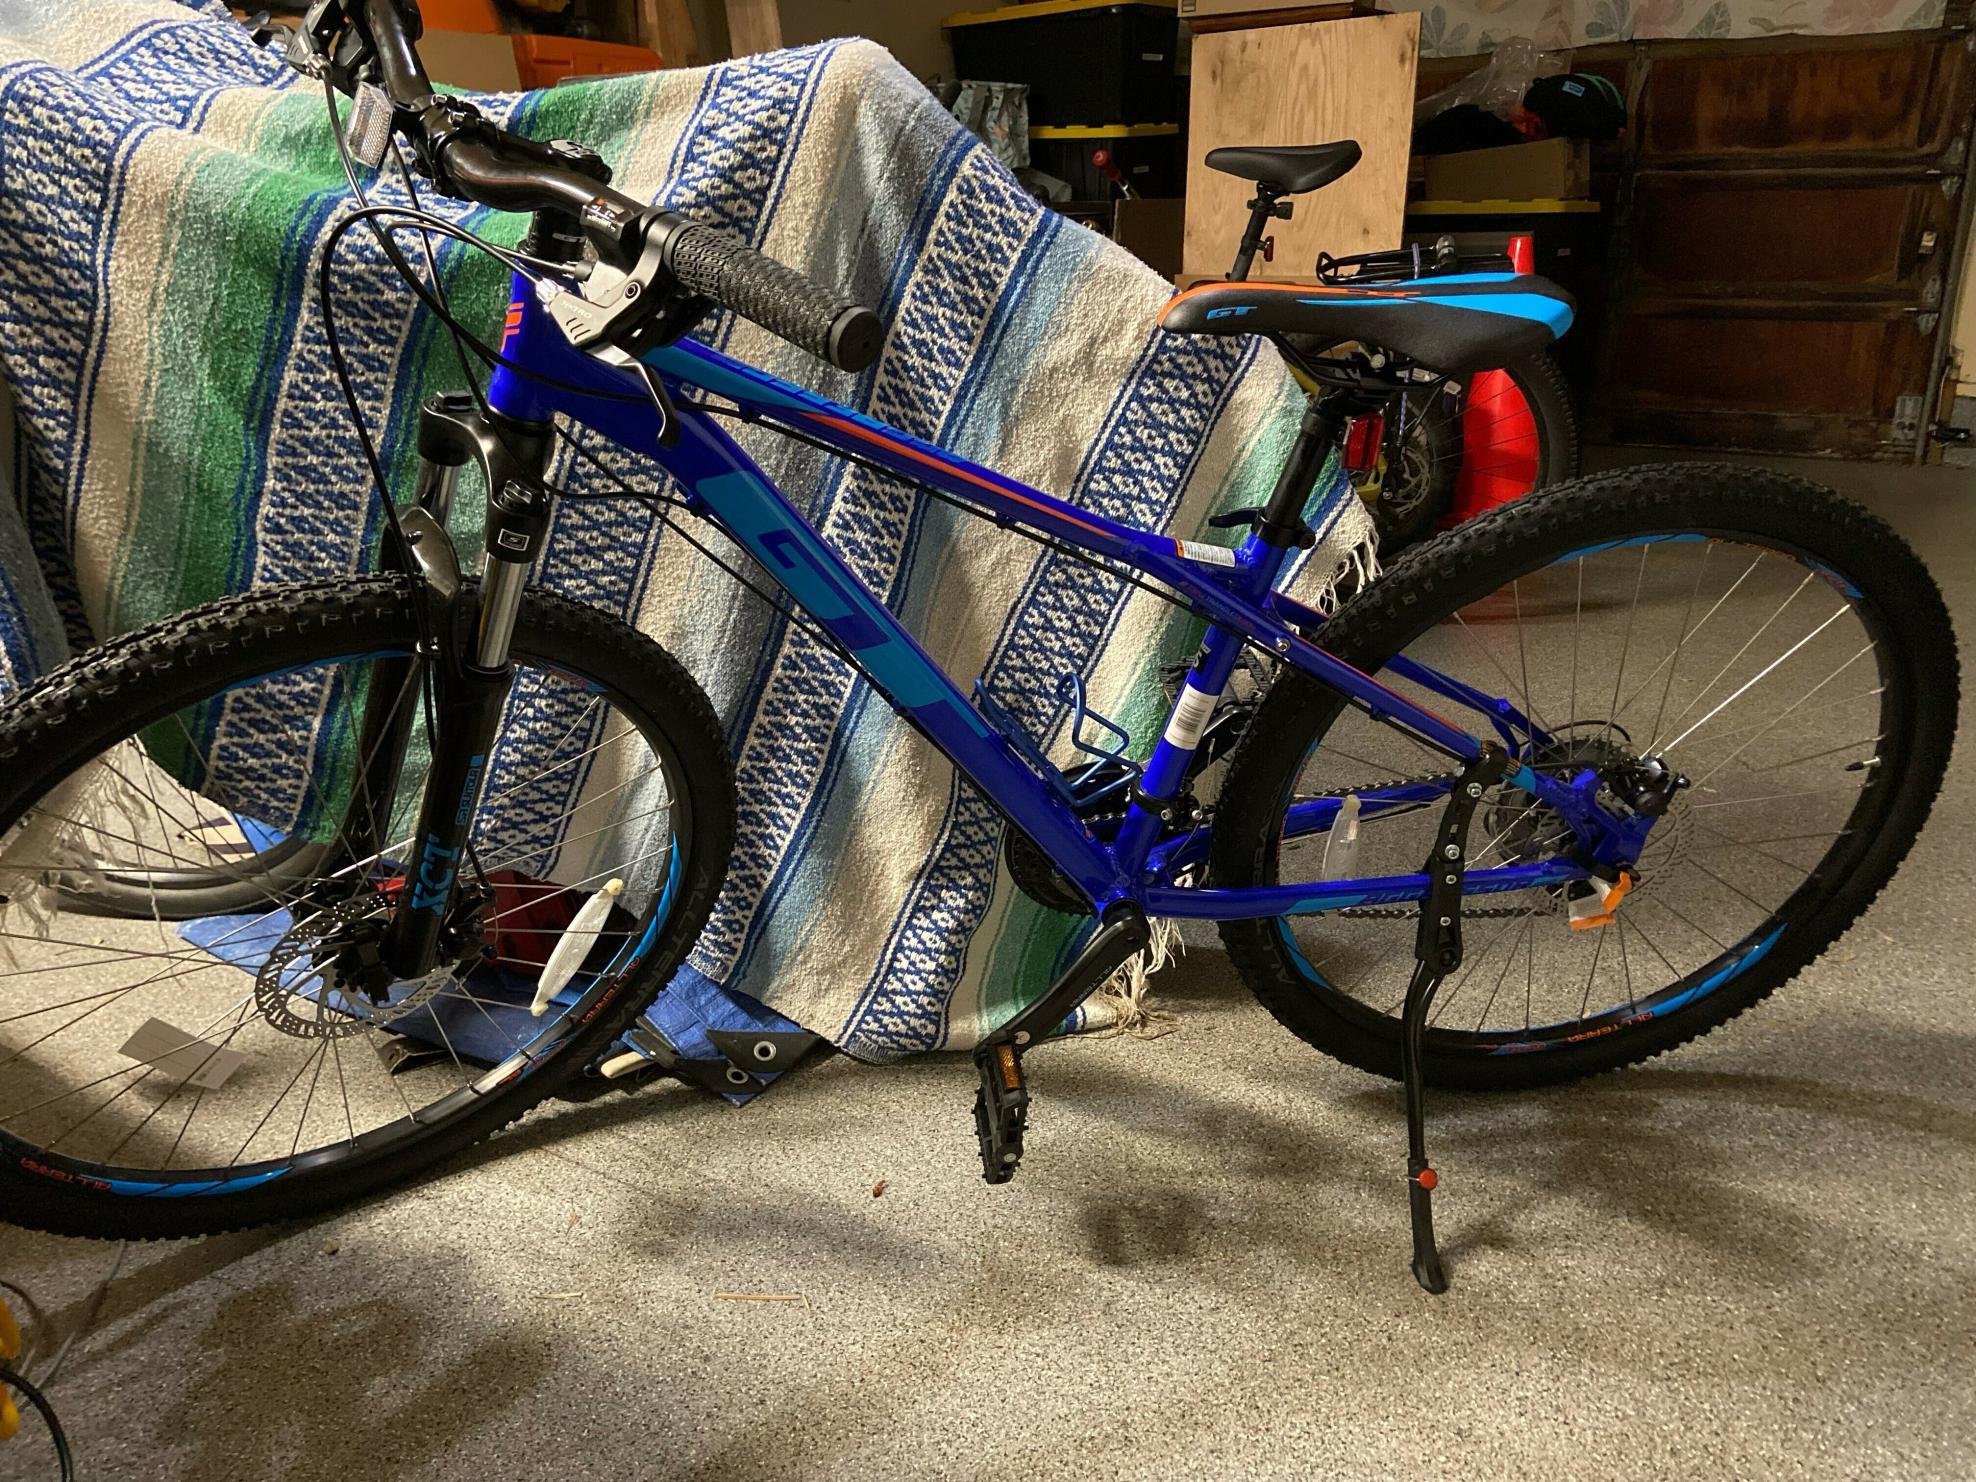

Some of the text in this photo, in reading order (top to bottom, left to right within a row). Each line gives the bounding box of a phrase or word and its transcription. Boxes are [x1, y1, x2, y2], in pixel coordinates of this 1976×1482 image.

[1207, 306, 1258, 320] GT
[696, 470, 990, 738] GT
[411, 833, 461, 916] XCT
